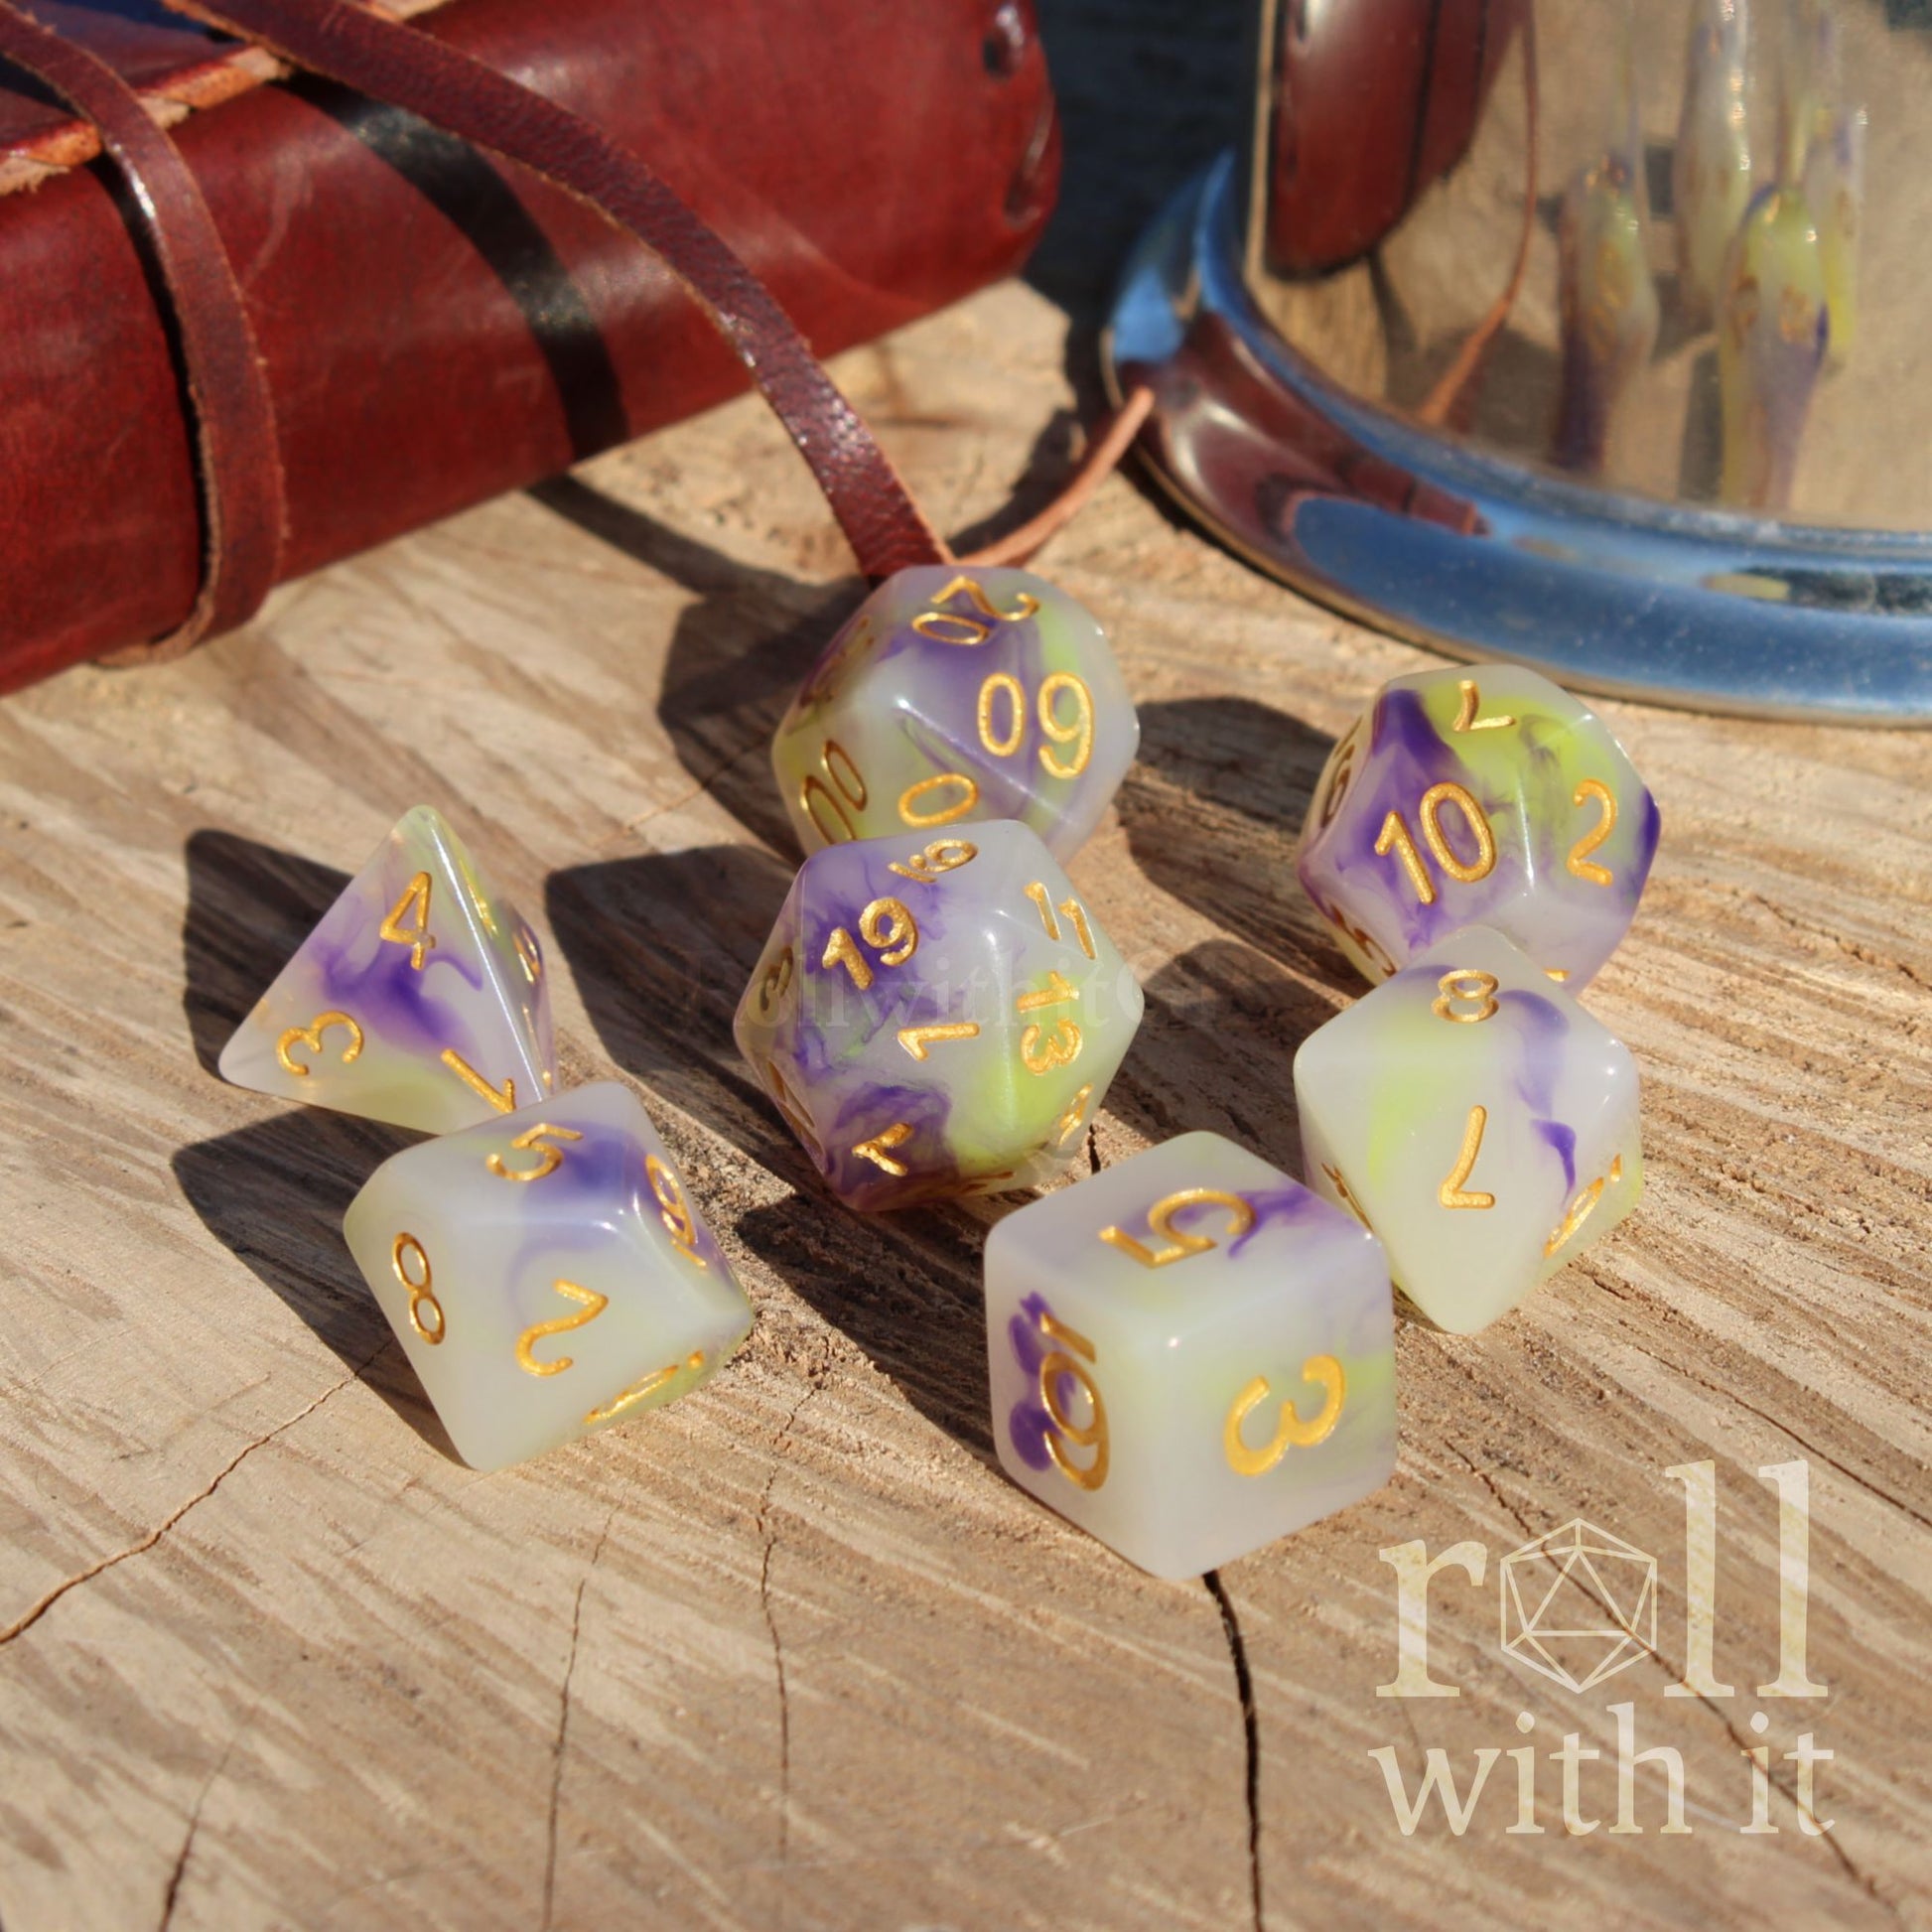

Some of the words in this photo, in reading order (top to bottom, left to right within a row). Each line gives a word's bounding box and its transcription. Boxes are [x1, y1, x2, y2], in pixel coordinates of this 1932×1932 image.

[1374, 780, 1498, 905] 10
[1566, 777, 1619, 887] 2
[379, 870, 436, 970] 4
[821, 896, 920, 991] 19
[1024, 881, 1097, 960] 11
[276, 1010, 365, 1077] 3
[1017, 970, 1084, 1076] 13
[1431, 969, 1500, 1024] 8
[485, 1121, 585, 1182] 5
[1438, 1105, 1496, 1210] 7
[1098, 1187, 1256, 1270] 5
[391, 1231, 447, 1346] 8
[514, 1278, 610, 1378] 2
[1223, 1353, 1347, 1478] 3
